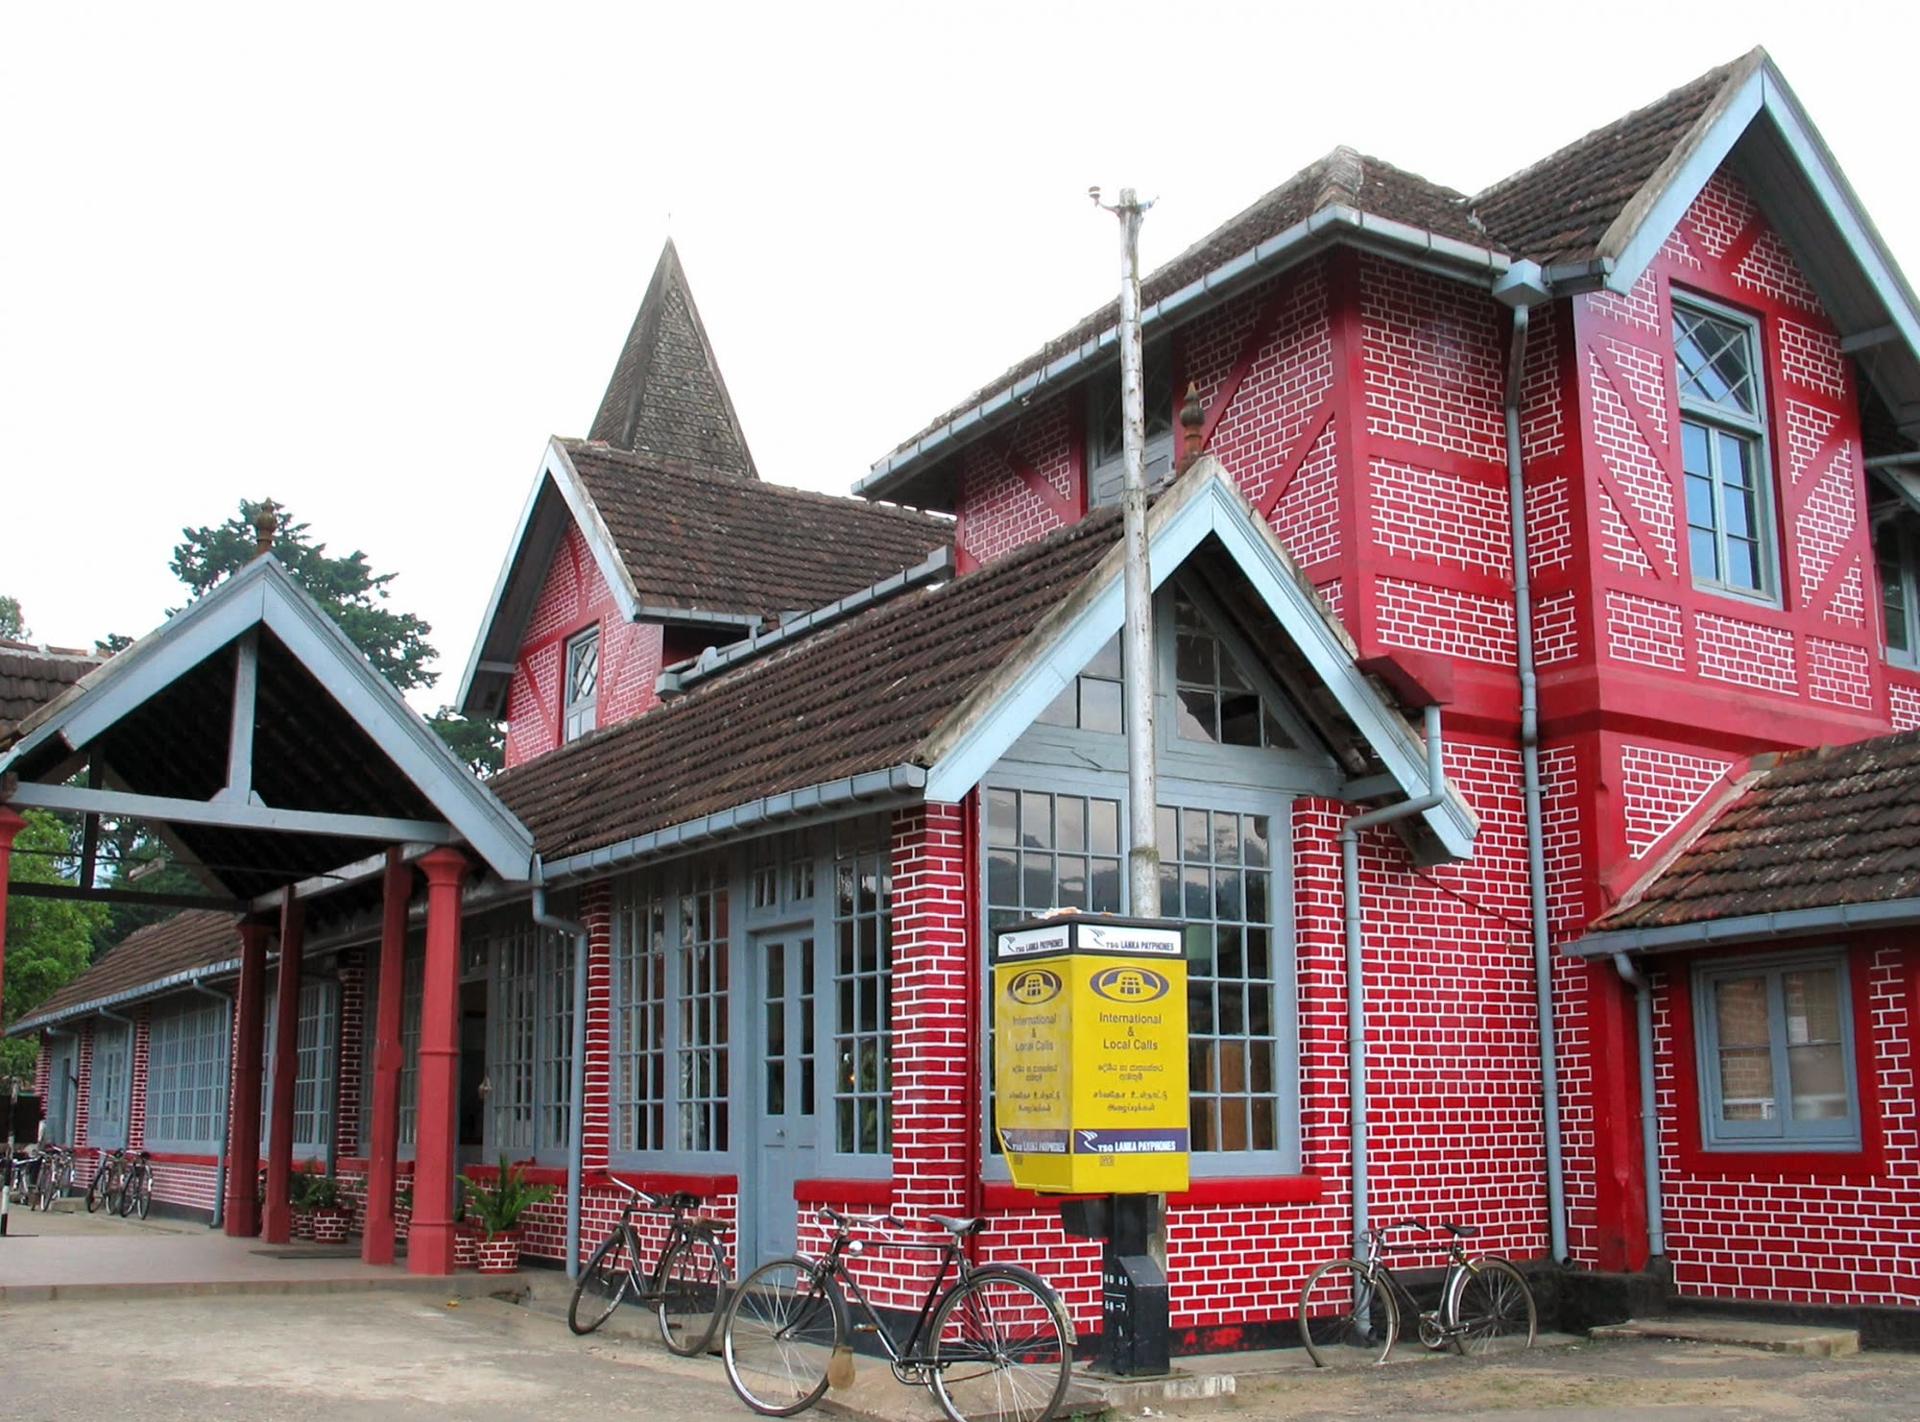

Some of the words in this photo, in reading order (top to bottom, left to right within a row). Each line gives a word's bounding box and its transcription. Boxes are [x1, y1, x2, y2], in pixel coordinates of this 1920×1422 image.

[1121, 941, 1140, 949] LANKA
[1141, 941, 1174, 951] PAYPHONES
[1013, 1013, 1057, 1024] International
[1099, 1012, 1162, 1024] International
[1127, 1026, 1135, 1037] &
[1015, 1042, 1034, 1052] Local
[1035, 1040, 1054, 1051] Calls
[1103, 1039, 1131, 1050] Local
[1133, 1039, 1158, 1050] Calls
[1114, 1141, 1137, 1152] LANKA
[1138, 1140, 1176, 1152] PAYPHONES
